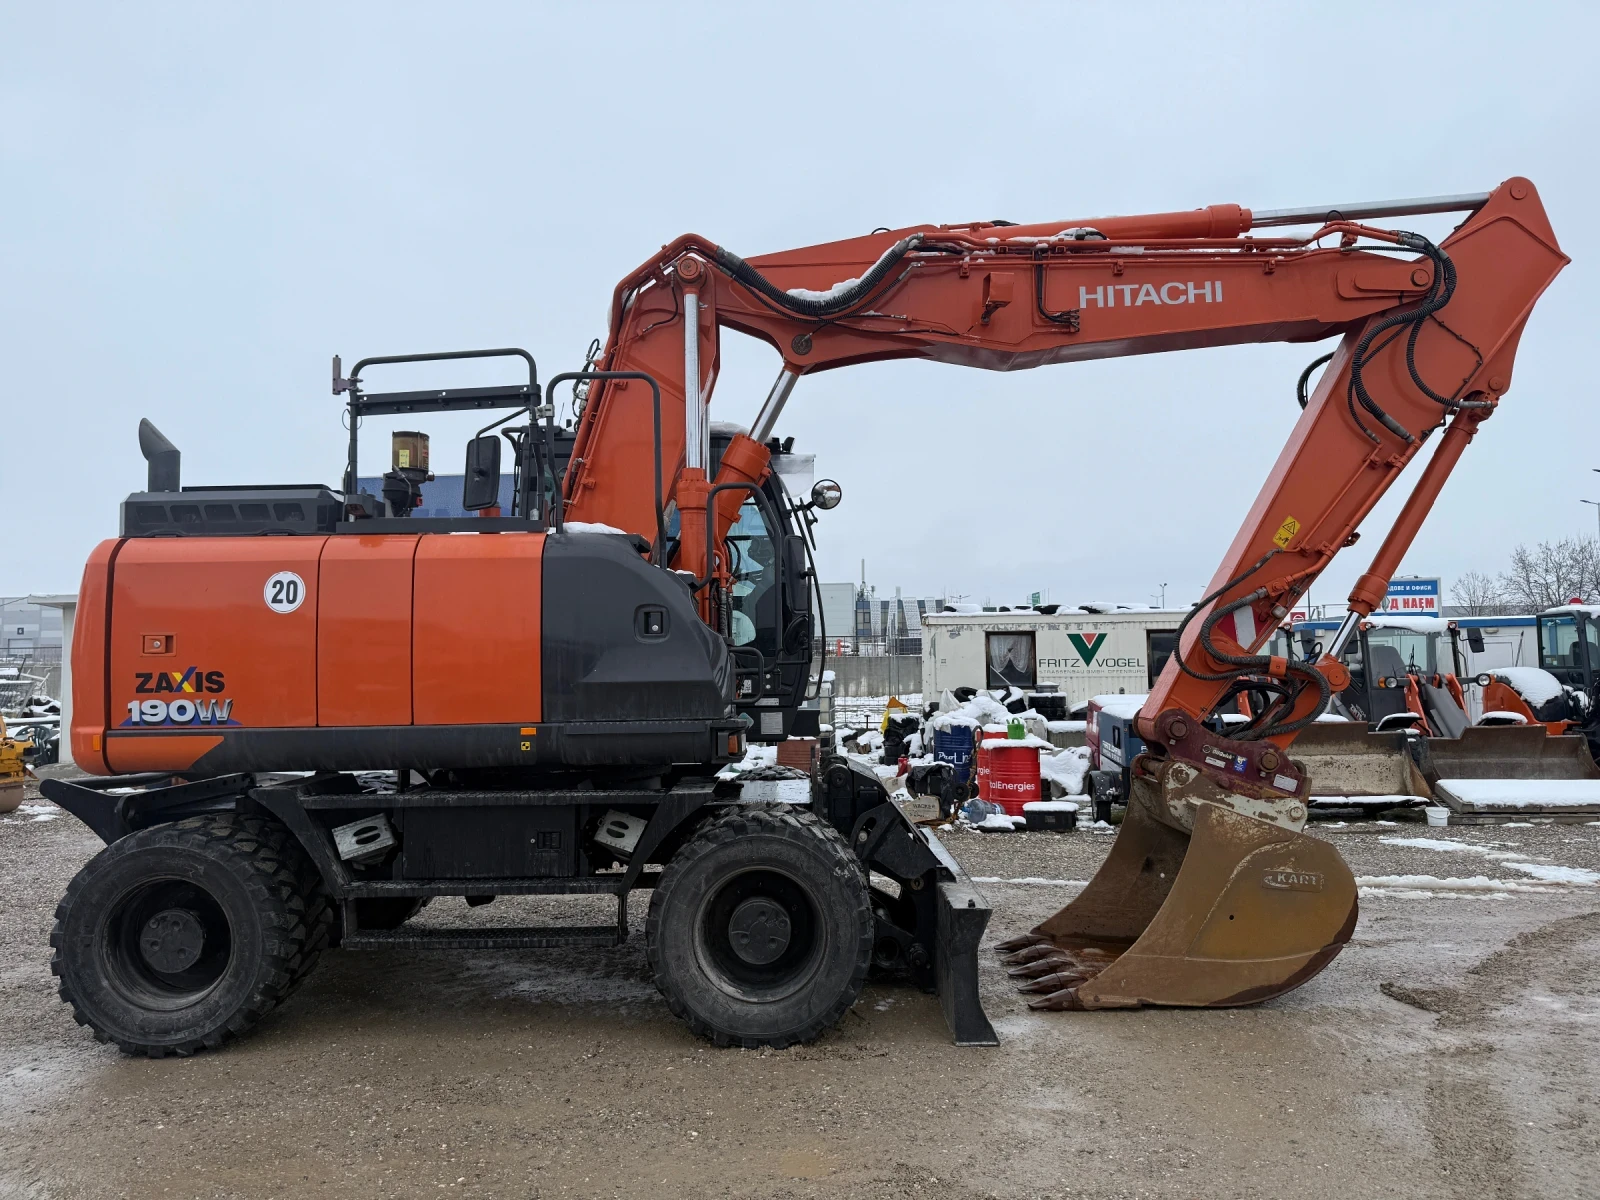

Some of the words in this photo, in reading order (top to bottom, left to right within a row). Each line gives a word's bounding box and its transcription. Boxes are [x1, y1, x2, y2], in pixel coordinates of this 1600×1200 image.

[1079, 280, 1222, 308] HITACHI
[271, 580, 298, 604] 20
[1403, 597, 1435, 609] НАЕМ
[1039, 658, 1081, 667] FRITZ
[1095, 658, 1145, 667] VOGEL
[135, 666, 225, 693] ZAXIS
[127, 698, 234, 725] 190W
[989, 781, 1035, 792] talEnergies
[1277, 873, 1319, 885] KART
